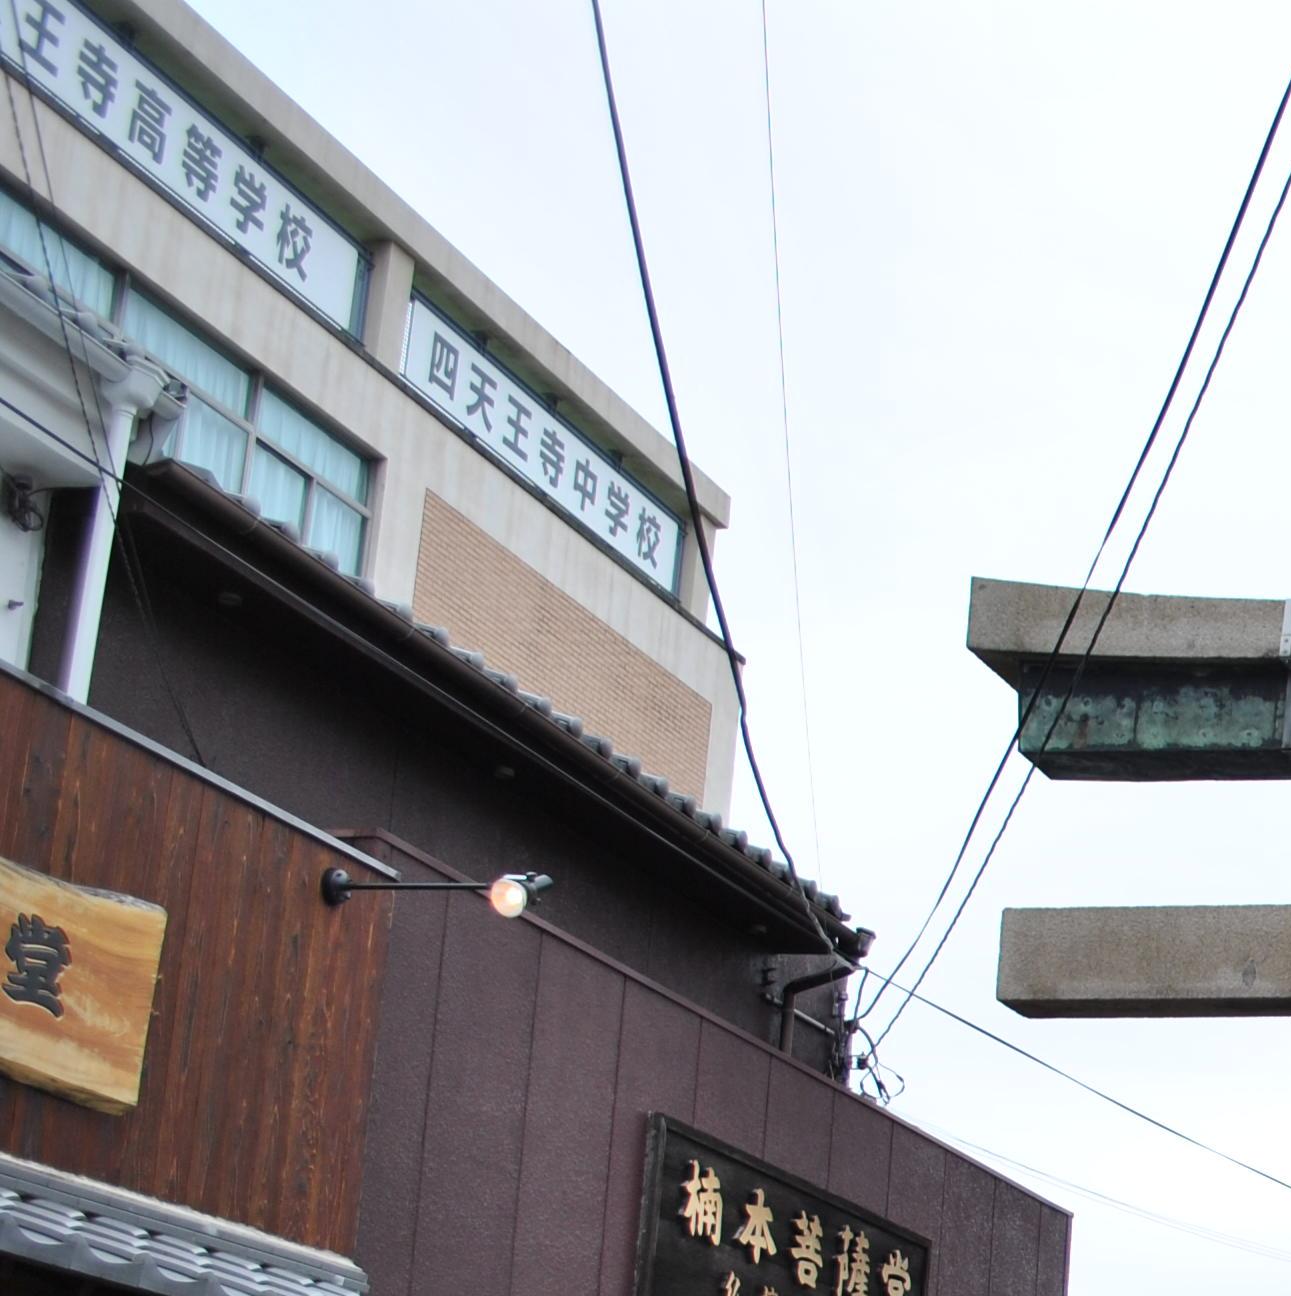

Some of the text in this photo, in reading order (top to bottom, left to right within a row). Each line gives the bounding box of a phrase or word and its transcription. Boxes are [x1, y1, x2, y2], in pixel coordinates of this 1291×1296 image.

[428, 331, 662, 570] 四天王寺中学校
[1, 908, 71, 1019] 堂
